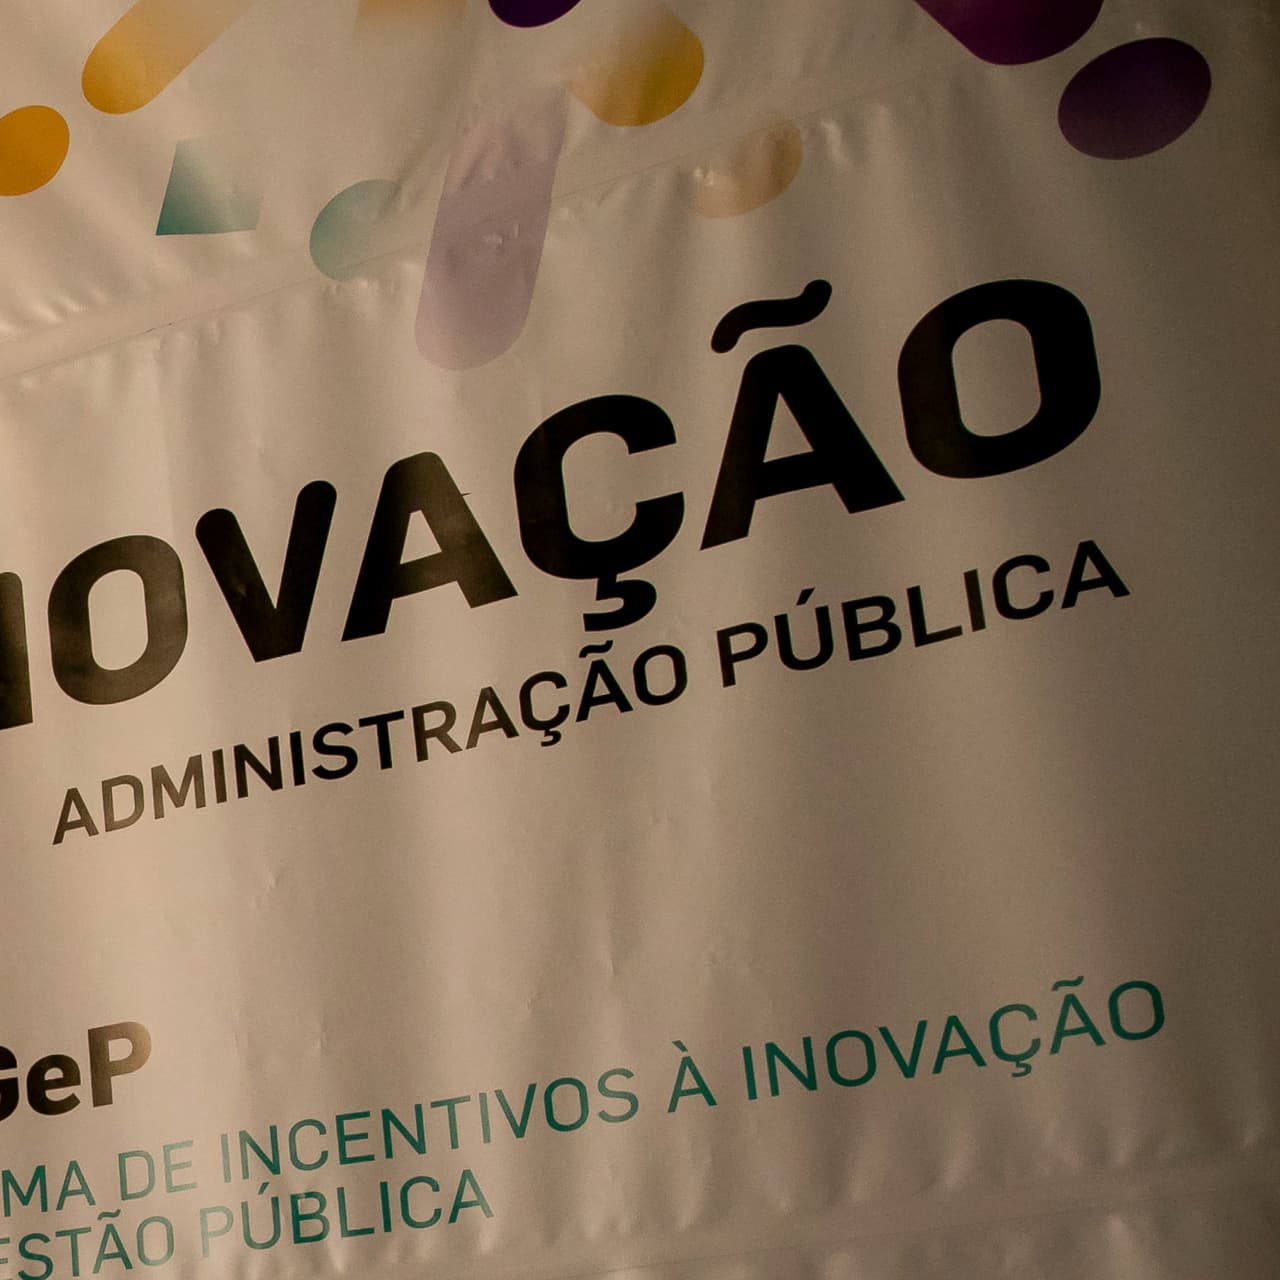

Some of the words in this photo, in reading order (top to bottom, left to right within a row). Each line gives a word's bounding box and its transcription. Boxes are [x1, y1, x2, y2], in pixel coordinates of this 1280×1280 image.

[52, 641, 689, 845] ADMINISTRAÇÃO
[716, 538, 1131, 689] PÚBLICA
[119, 1141, 199, 1204] DE
[219, 1066, 640, 1187] INCENTIVOS
[665, 1042, 712, 1112] À
[742, 975, 1169, 1100] INOVAÇÃO
[199, 1169, 494, 1258] PÚBLICA
